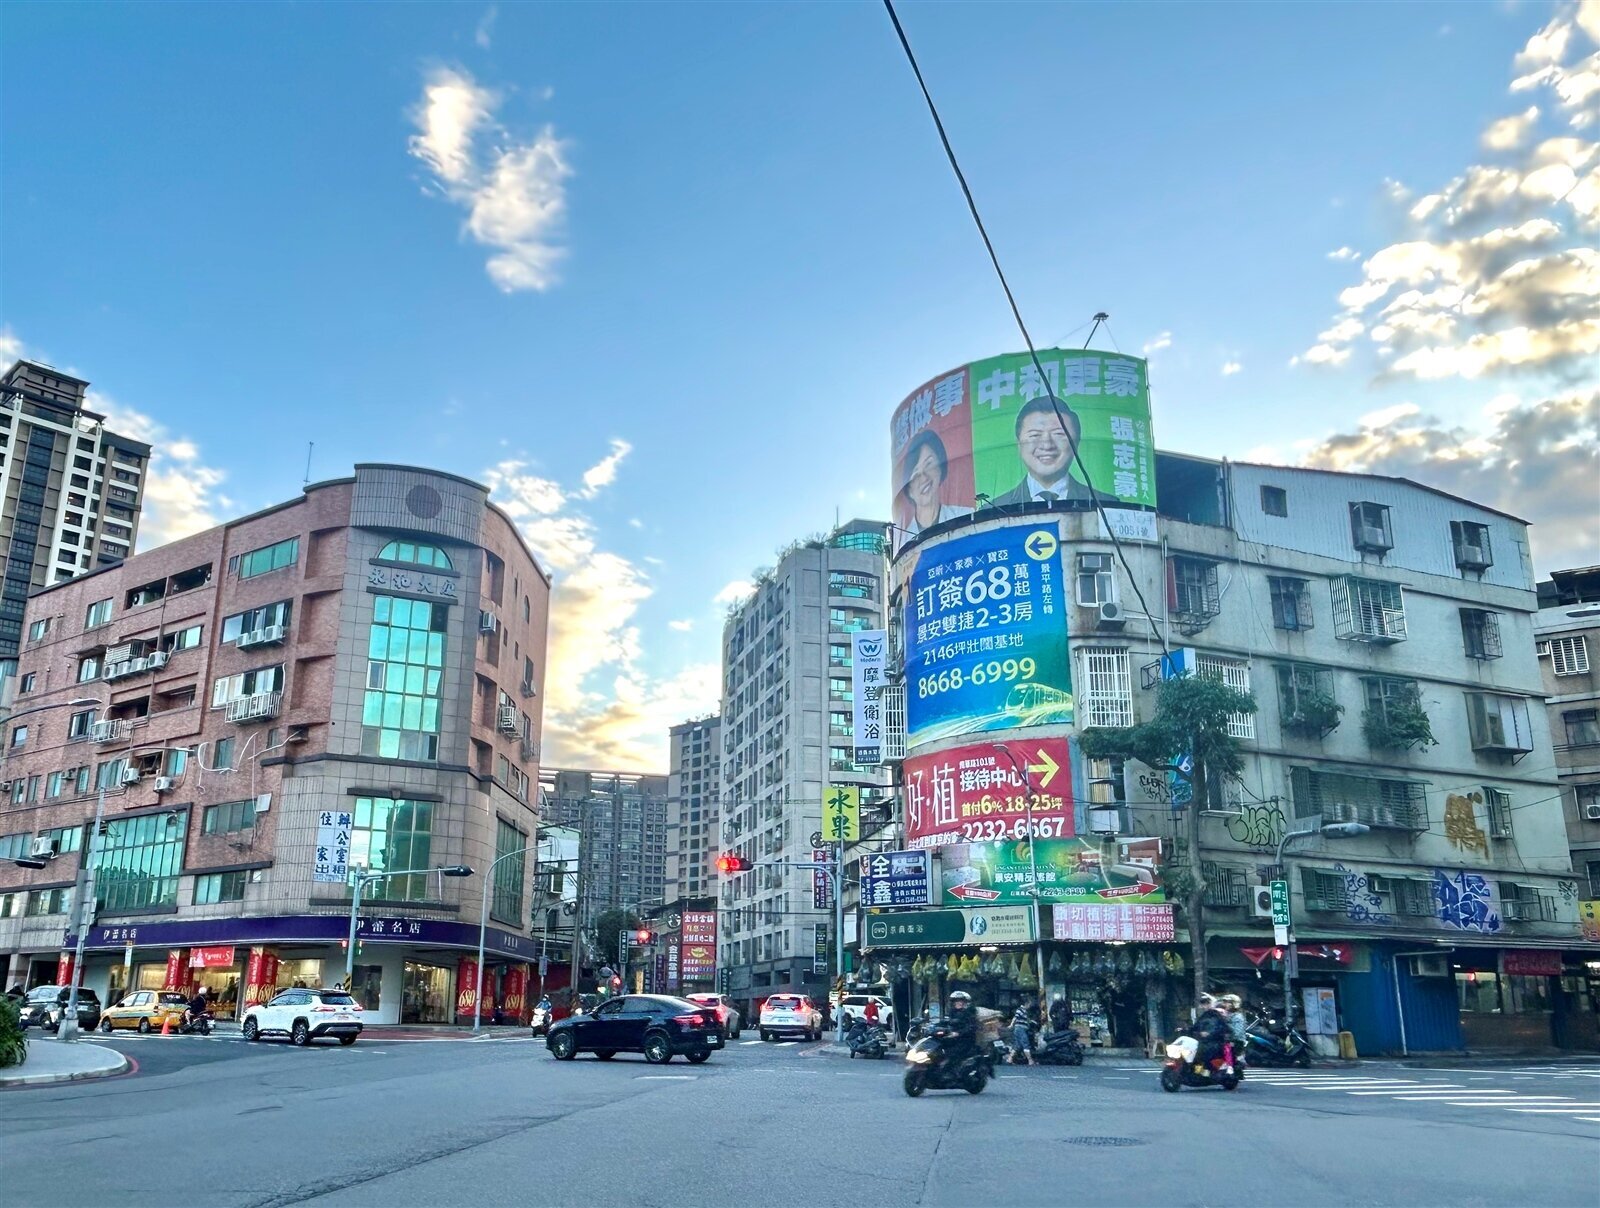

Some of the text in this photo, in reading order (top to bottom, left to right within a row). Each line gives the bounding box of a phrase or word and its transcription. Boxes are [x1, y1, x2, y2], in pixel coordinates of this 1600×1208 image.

[977, 357, 1139, 410] 中和更豪
[1110, 415, 1138, 498] 張志豪
[918, 657, 1036, 699] 8668-6999
[863, 667, 880, 740] 摩登衛浴
[959, 766, 1023, 792] 接待中心
[828, 789, 855, 838] 水果
[871, 855, 892, 904] 全鑫
[994, 872, 1056, 883] 景安精品旅館
[459, 989, 476, 1007] 680
